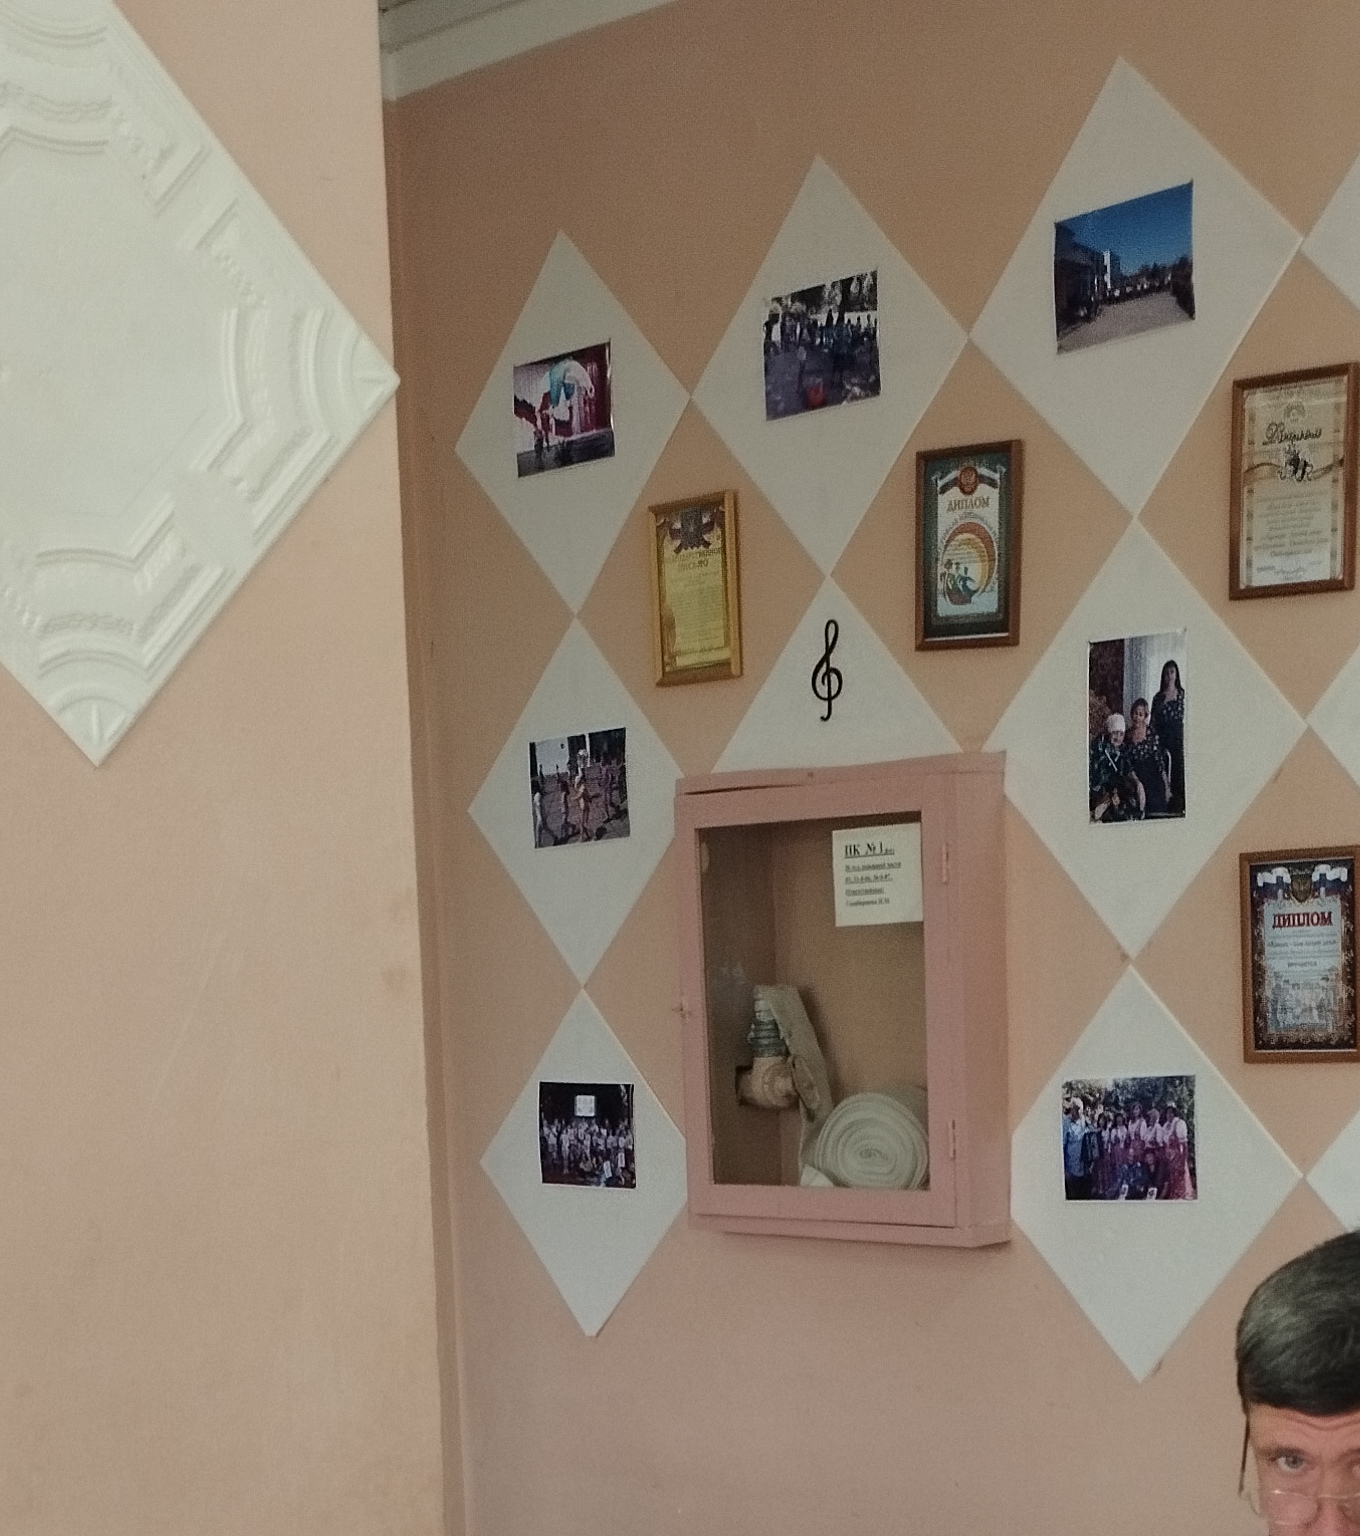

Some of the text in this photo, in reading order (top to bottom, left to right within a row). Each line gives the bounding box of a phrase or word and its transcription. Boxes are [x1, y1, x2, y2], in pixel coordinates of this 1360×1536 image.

[947, 497, 990, 512] ДИПЛОМ
[845, 844, 860, 857] ПК
[1272, 911, 1334, 930] ДИПЛОМ
